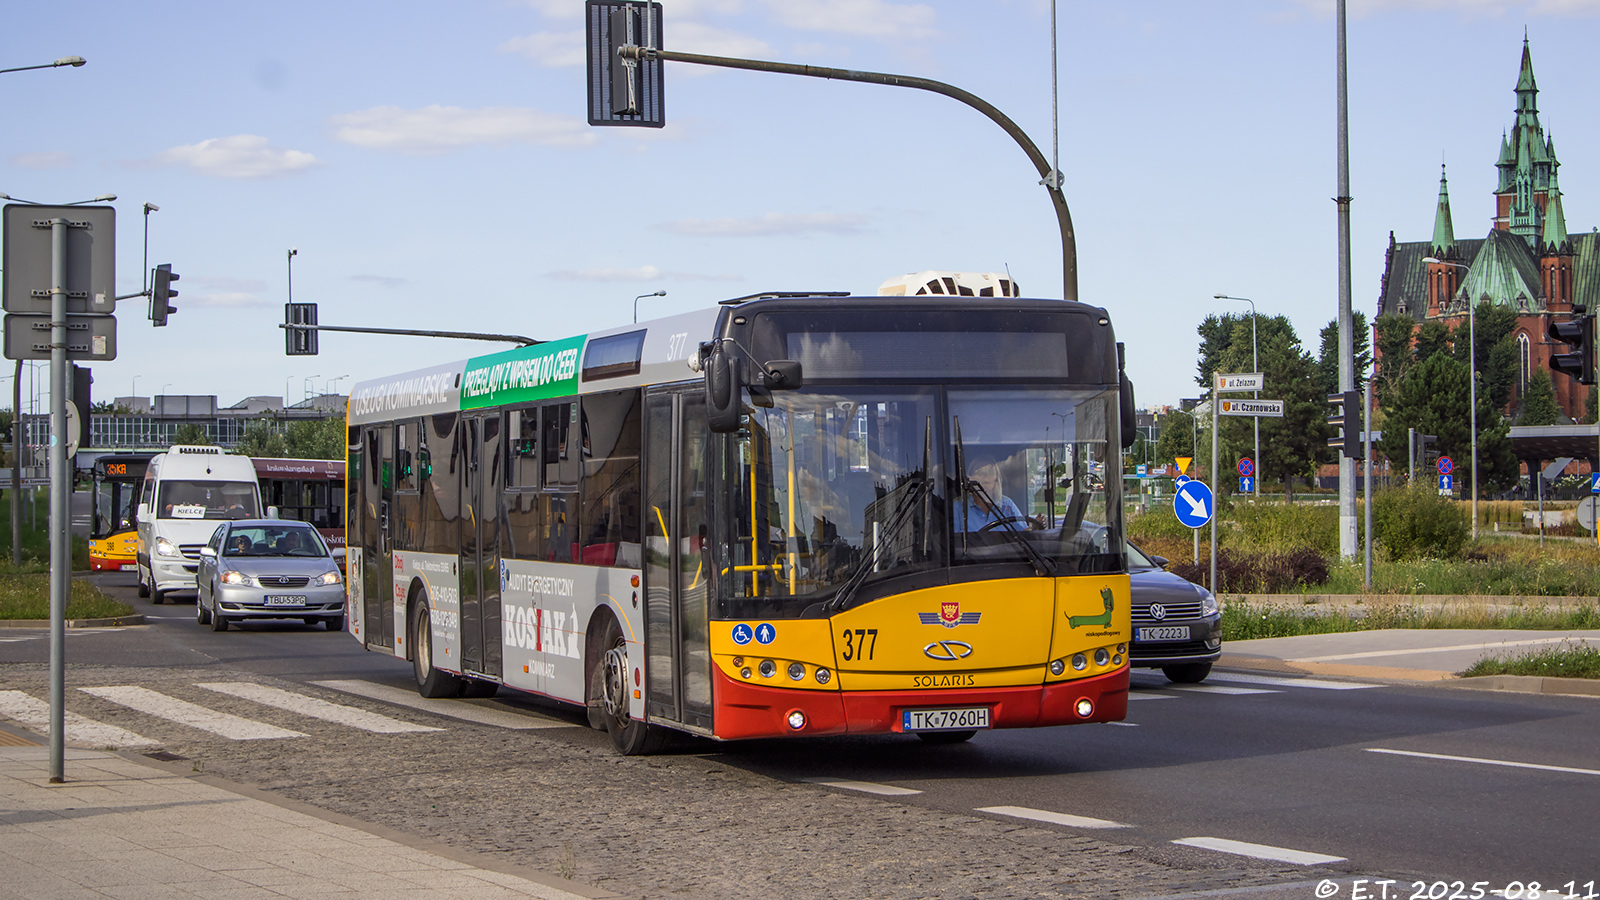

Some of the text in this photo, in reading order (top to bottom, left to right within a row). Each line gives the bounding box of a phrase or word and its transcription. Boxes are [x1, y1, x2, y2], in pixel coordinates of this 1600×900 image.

[667, 333, 688, 361] 377
[463, 348, 578, 400] PRZEGLĄDY Z WPISEM DO CEEB
[1236, 377, 1256, 387] Żelazna
[384, 372, 452, 411] KOMINIARSKIE
[1232, 403, 1280, 412] ul. Czarnowska
[508, 573, 574, 597] AUDYT ENERGETYCZNY
[269, 596, 285, 605] TBU
[504, 604, 567, 658] KOSIAK
[1141, 628, 1188, 640] TK 2223J
[842, 629, 878, 661] 377
[528, 659, 555, 679] KOMINIARZ
[913, 674, 975, 687] SOLARIS
[914, 712, 935, 729] TK
[940, 710, 986, 727] 7960H
